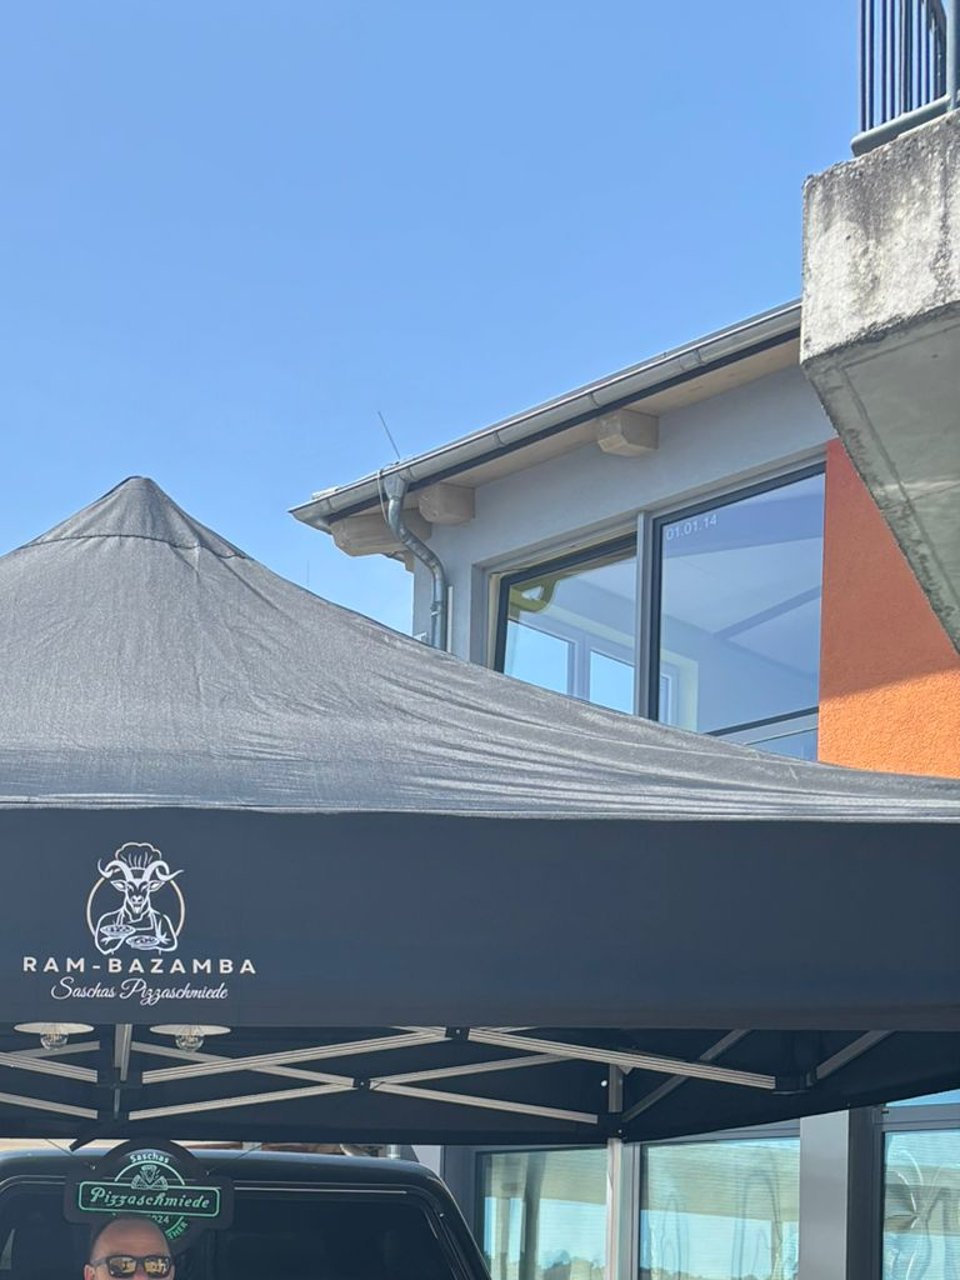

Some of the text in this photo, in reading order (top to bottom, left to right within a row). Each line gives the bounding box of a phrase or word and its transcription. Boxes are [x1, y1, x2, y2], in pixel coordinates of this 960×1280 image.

[666, 514, 717, 540] 01.01.14
[23, 957, 256, 974] RAM-BAZAMBA
[50, 976, 228, 1005] Saschas Pizzaschmiede
[129, 1152, 170, 1164] Saschas
[90, 1186, 210, 1209] Pizzaschmiede
